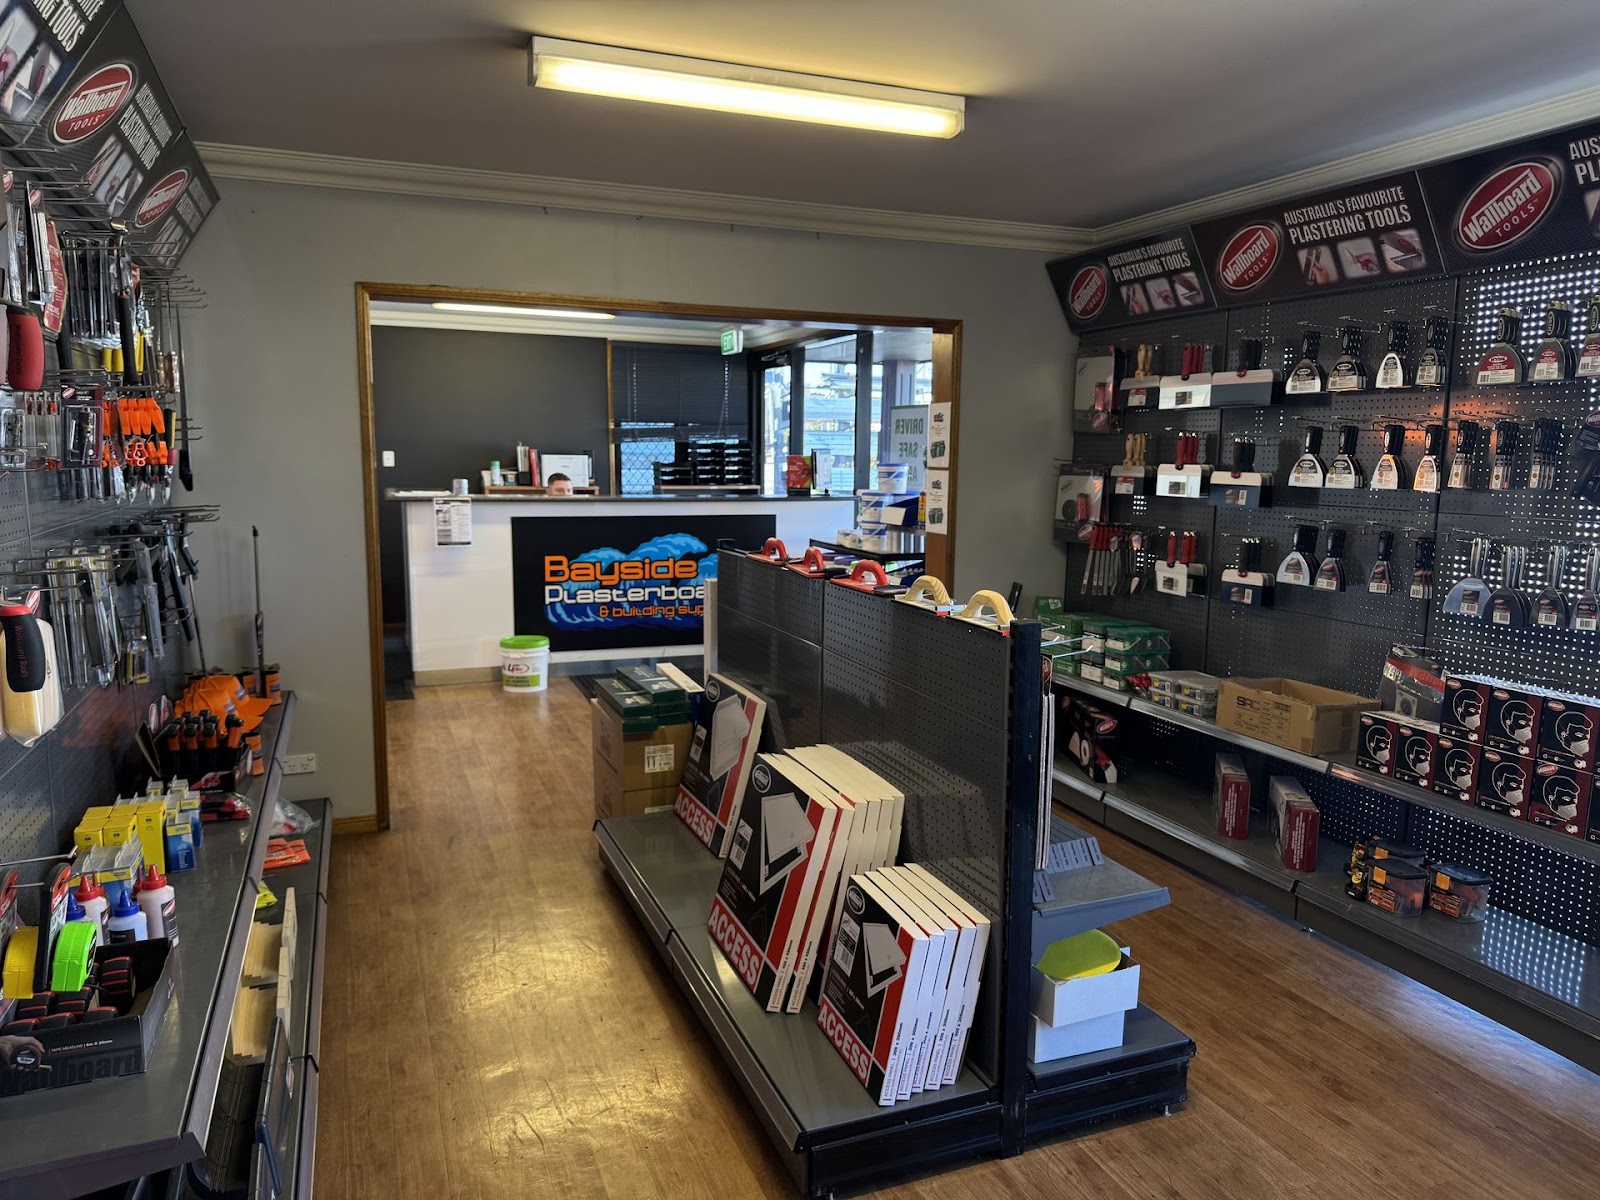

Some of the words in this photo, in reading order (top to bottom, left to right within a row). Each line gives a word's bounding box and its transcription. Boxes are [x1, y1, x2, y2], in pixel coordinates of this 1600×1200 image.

[48, 0, 85, 52] TOOLS
[58, 81, 128, 122] Wallboard
[68, 114, 101, 132] TOOLS
[1569, 137, 1600, 160] AUS
[1284, 200, 1346, 226] AUSTRALIA'S
[1346, 186, 1405, 212] FAVOURITE
[1289, 216, 1366, 244] PLASTERING
[1365, 204, 1412, 230] TOOLS
[1464, 168, 1542, 242] Wallboard
[1496, 203, 1535, 236] TOOLS
[1107, 247, 1148, 268] AUSTRALIA'S
[1146, 238, 1185, 258] FAVOURITE
[1112, 260, 1163, 282] PLASTERING
[1160, 252, 1190, 272] TOOLS
[1223, 229, 1272, 284] Wallboard
[1244, 256, 1268, 281] TOOLS
[1072, 270, 1102, 314] Wallboard
[1086, 293, 1101, 312] TOOLS
[544, 556, 698, 586] Bayside
[600, 605, 608, 618] &
[612, 606, 675, 618] building
[674, 792, 713, 844] ACCESS
[708, 904, 759, 986] ACCESS
[818, 1002, 868, 1080] ACCESS
